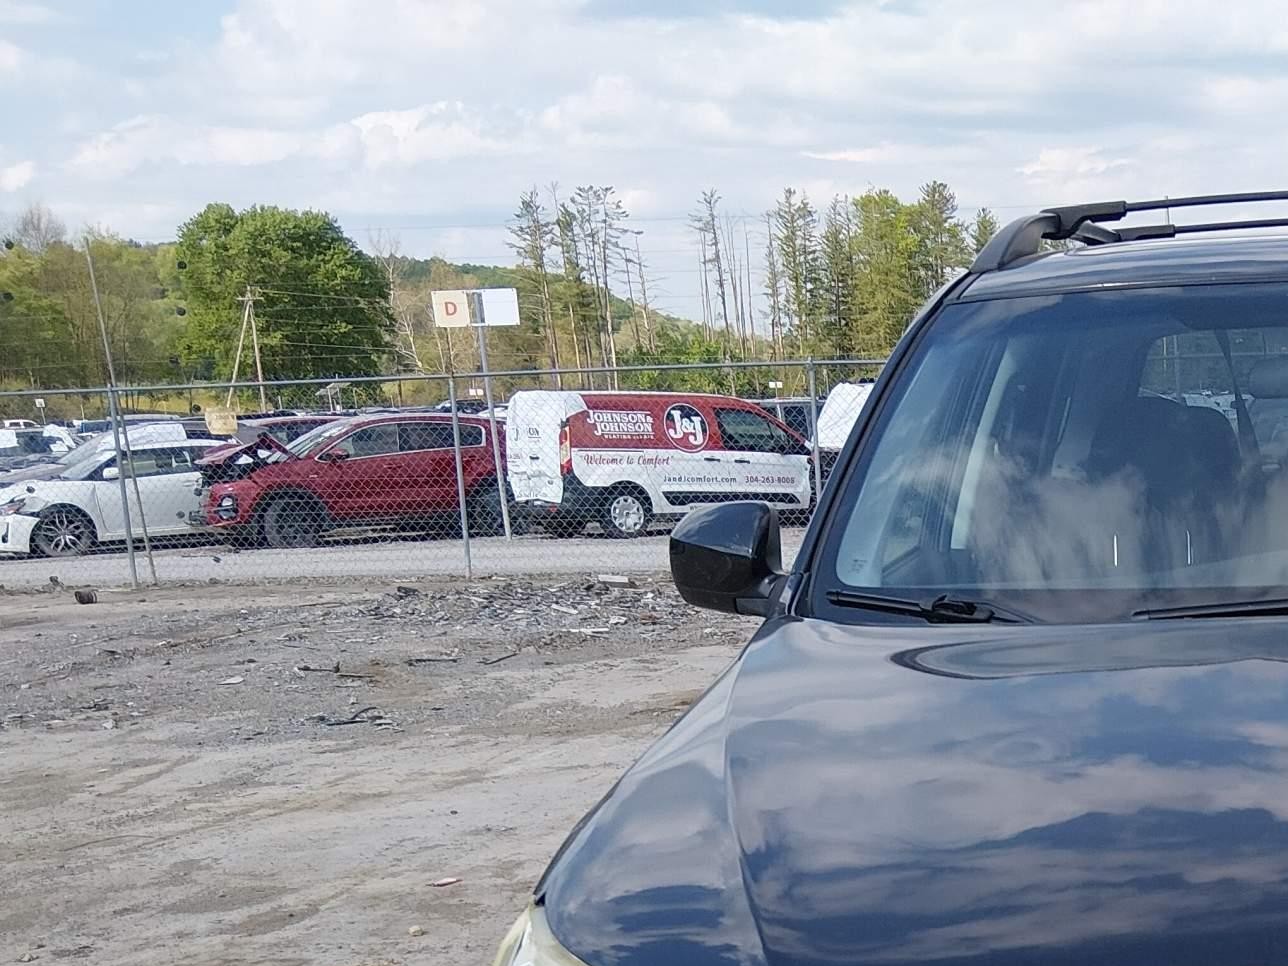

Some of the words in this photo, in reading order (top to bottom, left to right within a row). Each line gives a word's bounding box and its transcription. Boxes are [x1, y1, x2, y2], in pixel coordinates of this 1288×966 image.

[444, 301, 457, 316] D
[586, 409, 646, 424] JOHNSON
[594, 422, 653, 436] JOHNSON
[668, 409, 704, 446] J&J
[626, 455, 634, 465] to
